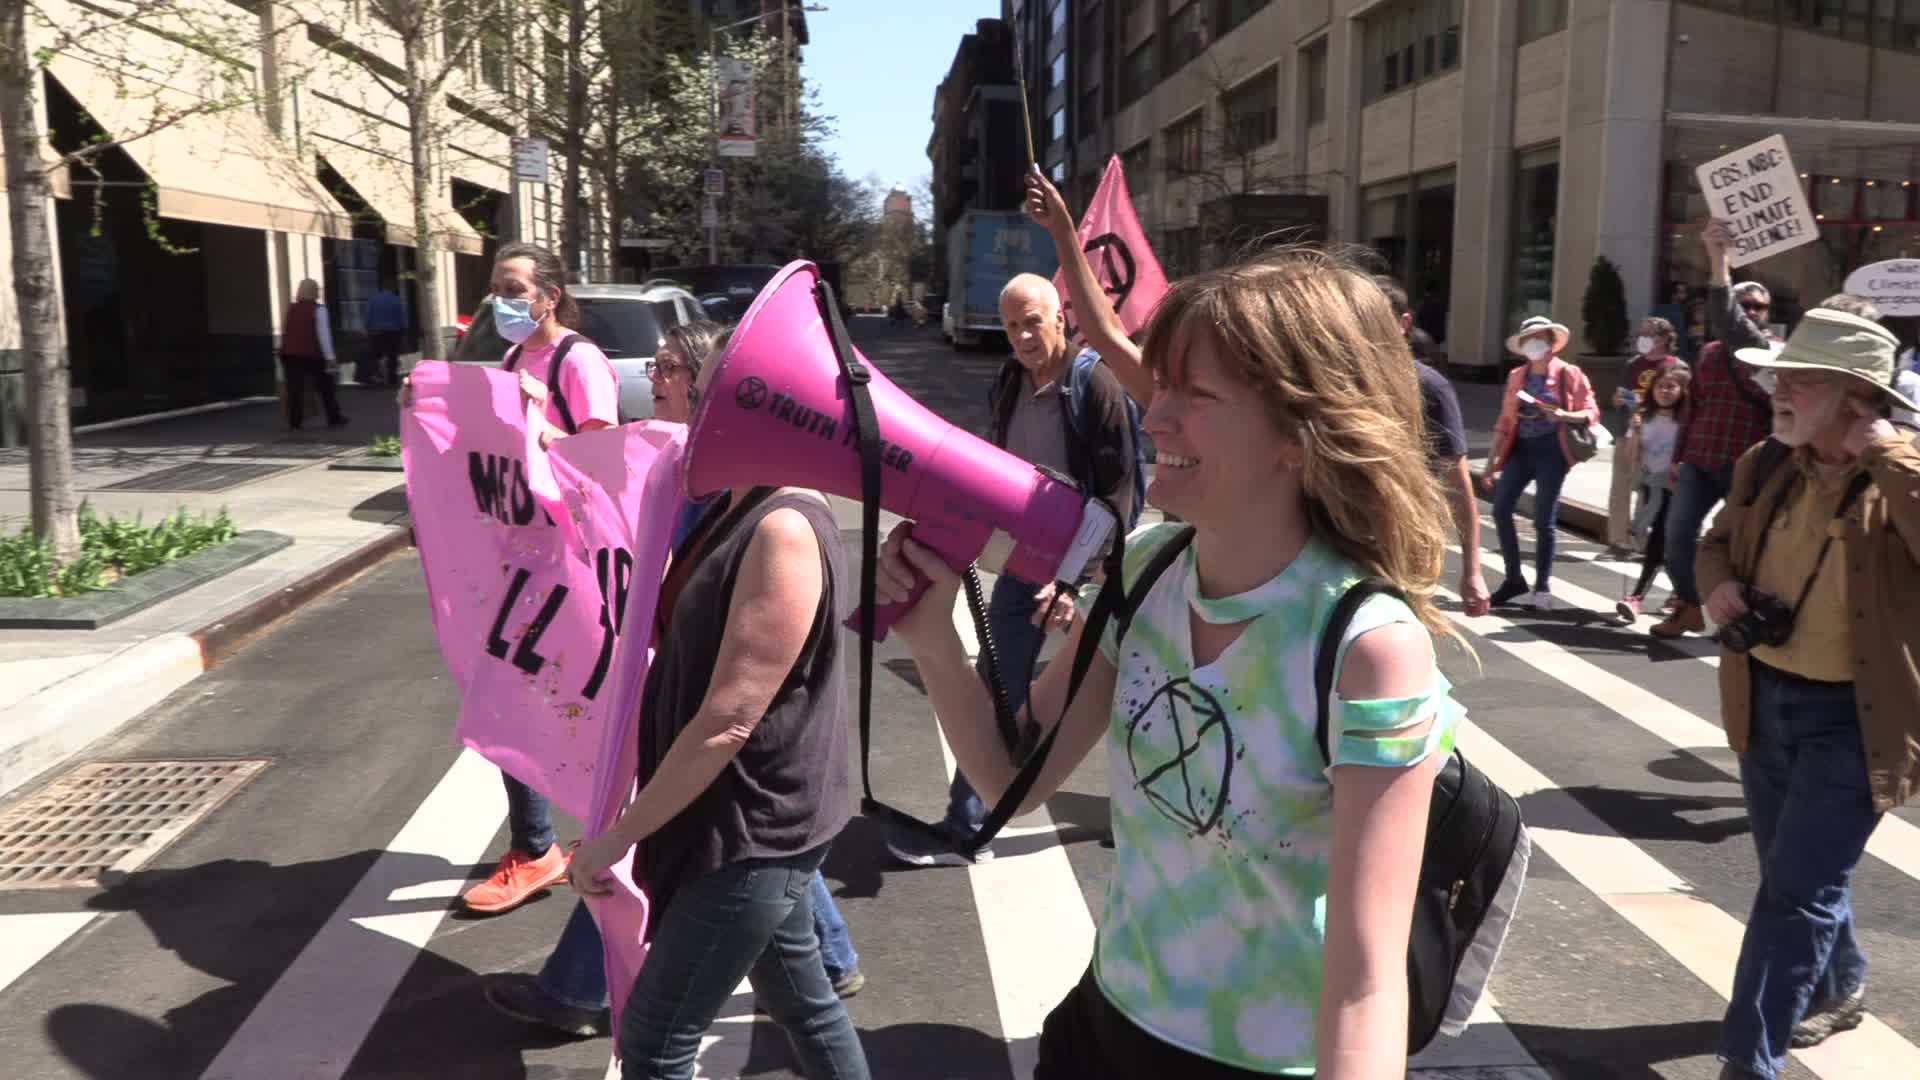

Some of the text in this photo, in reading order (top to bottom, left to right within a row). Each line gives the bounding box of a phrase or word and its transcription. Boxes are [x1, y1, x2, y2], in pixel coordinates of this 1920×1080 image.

[1723, 182, 1773, 215] END
[1736, 219, 1806, 256] SILENCE!
[769, 392, 839, 441] TRUTH
